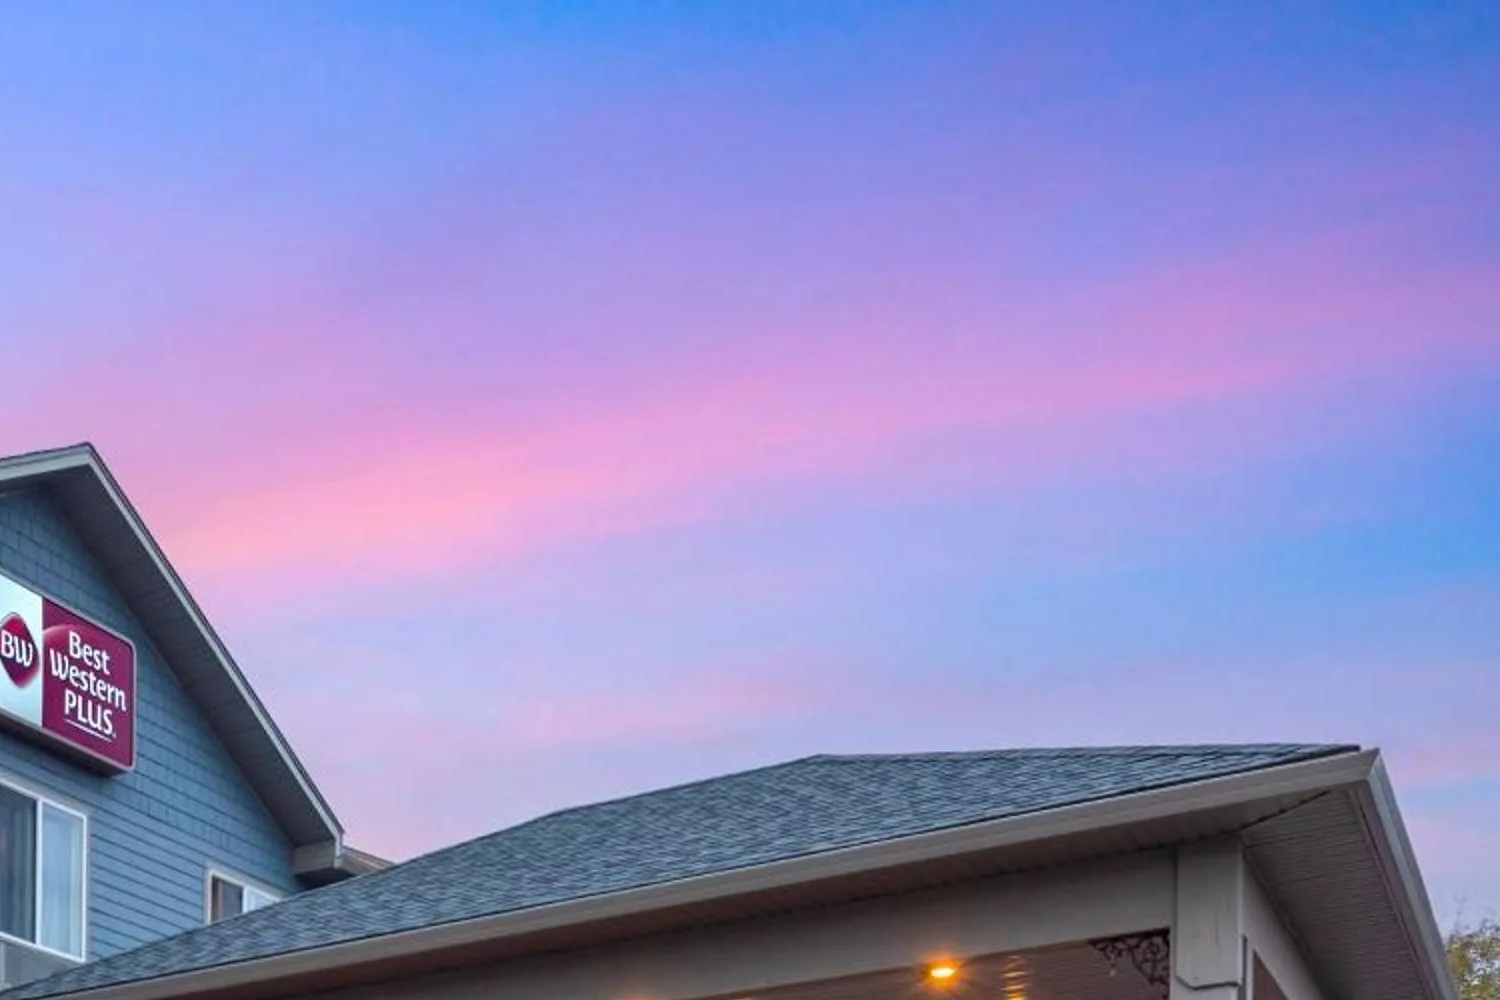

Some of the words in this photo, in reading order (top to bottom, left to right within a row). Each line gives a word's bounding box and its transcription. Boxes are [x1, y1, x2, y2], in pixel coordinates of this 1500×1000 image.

[0, 630, 33, 667] BW
[68, 631, 111, 675] Best
[50, 647, 127, 712] Western
[64, 689, 114, 736] PLUS
